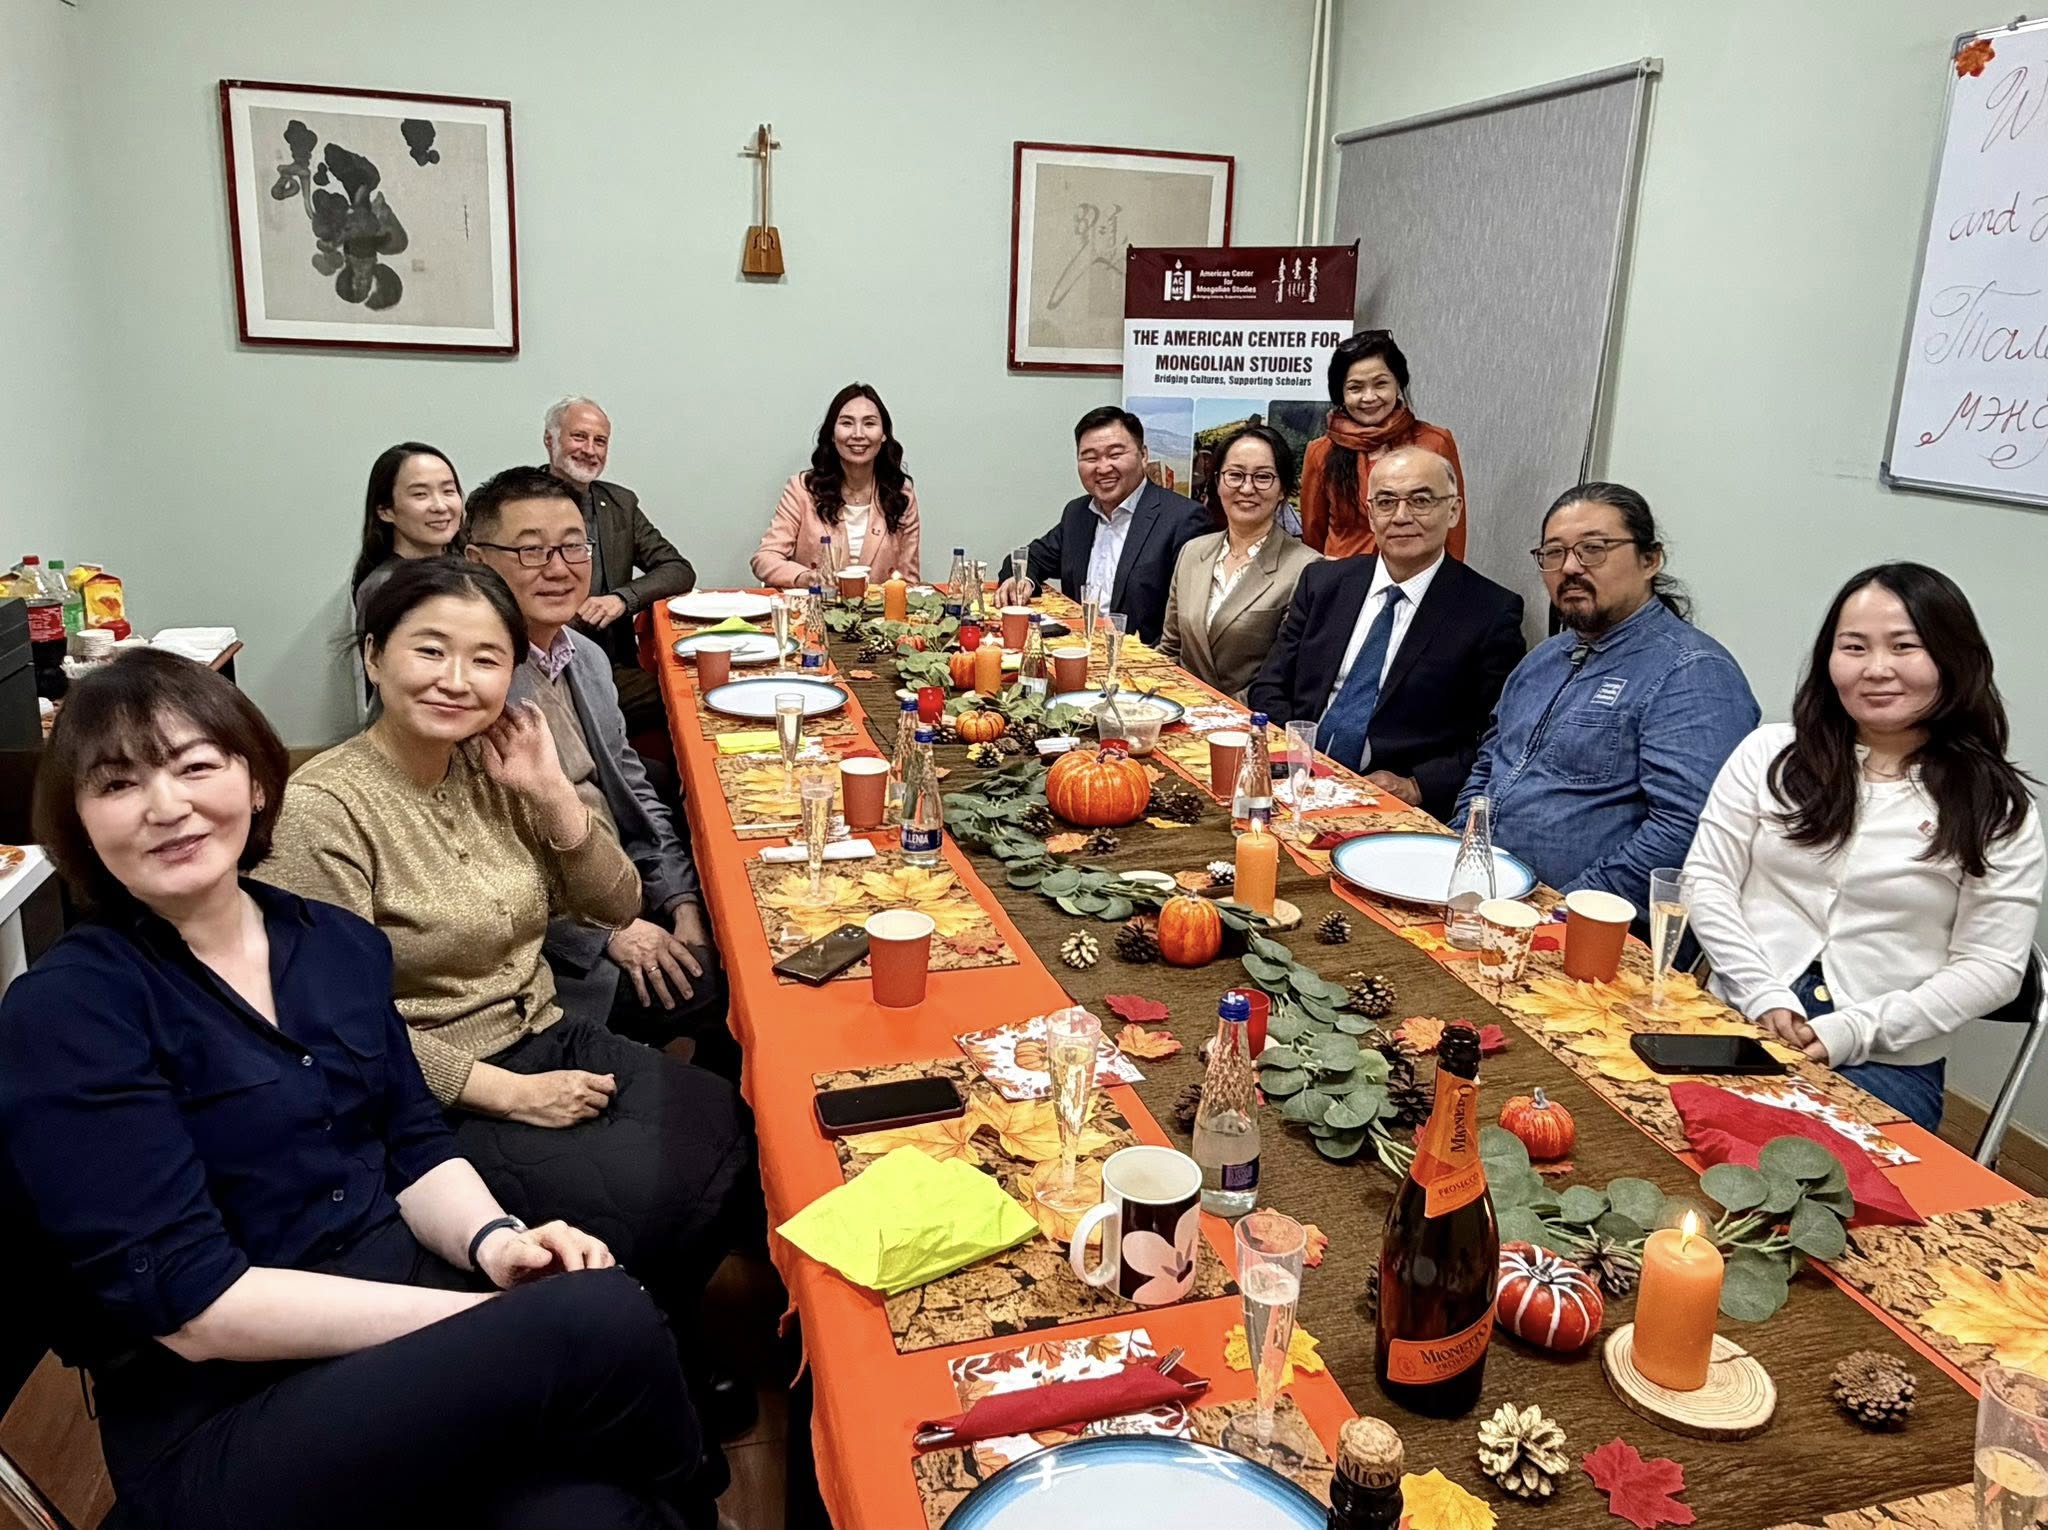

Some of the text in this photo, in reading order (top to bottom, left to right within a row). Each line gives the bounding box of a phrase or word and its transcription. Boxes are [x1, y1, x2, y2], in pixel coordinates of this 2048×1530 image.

[1950, 191, 2020, 241] and
[1199, 269, 1254, 278] American Center
[1223, 278, 1234, 286] for
[1196, 285, 1257, 295] Mongolian Studies
[1133, 330, 1341, 348] THE AMERICAN CENTER FOR
[1155, 354, 1313, 373] MONGOLIAN STUDIES
[1154, 374, 1312, 387] Bridging Cultures, Supporting Scholars
[1419, 1323, 1489, 1366] MIONETTO
